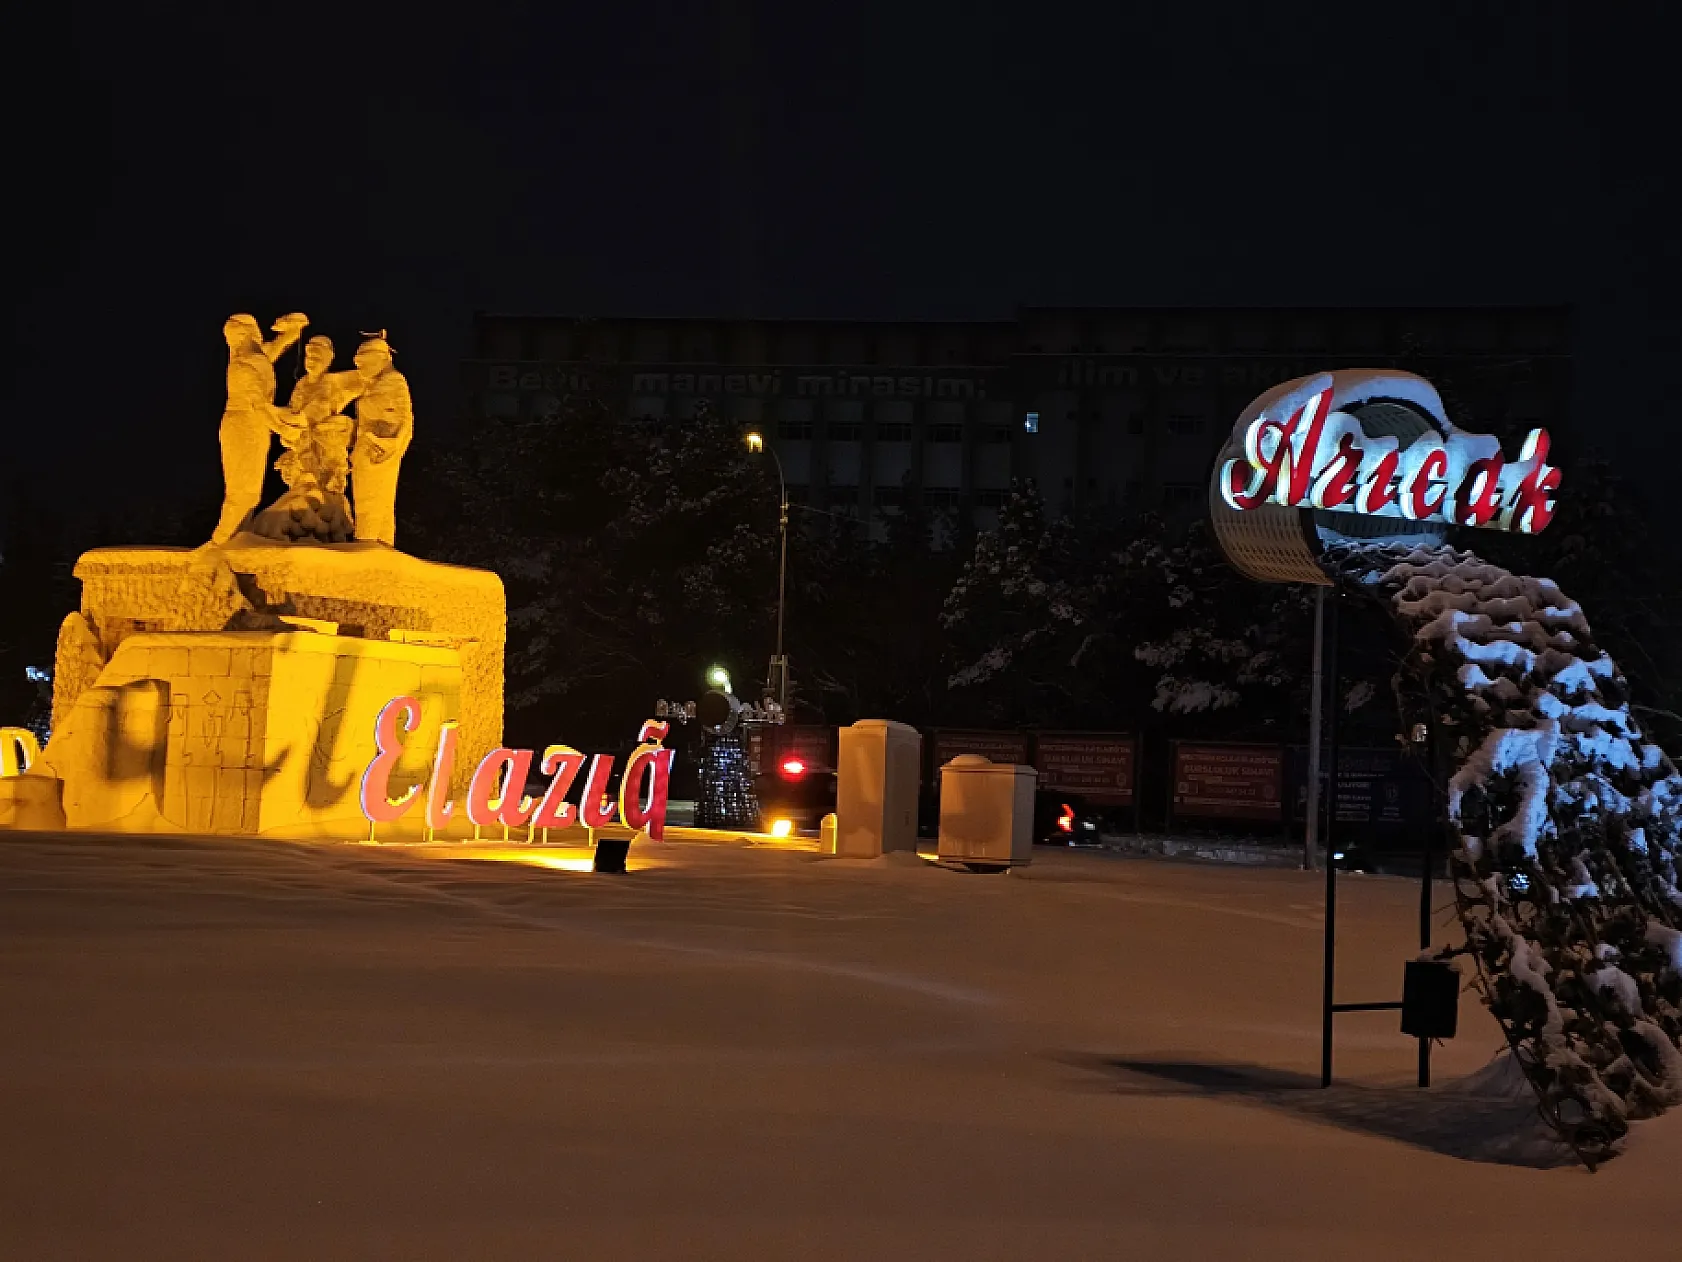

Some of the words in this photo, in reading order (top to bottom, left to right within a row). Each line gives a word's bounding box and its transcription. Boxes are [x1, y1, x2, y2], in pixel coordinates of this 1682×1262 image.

[633, 370, 782, 394] manevi
[1153, 365, 1206, 387] ve
[1222, 385, 1562, 534] Arıcak
[360, 695, 676, 842] Elazığ
